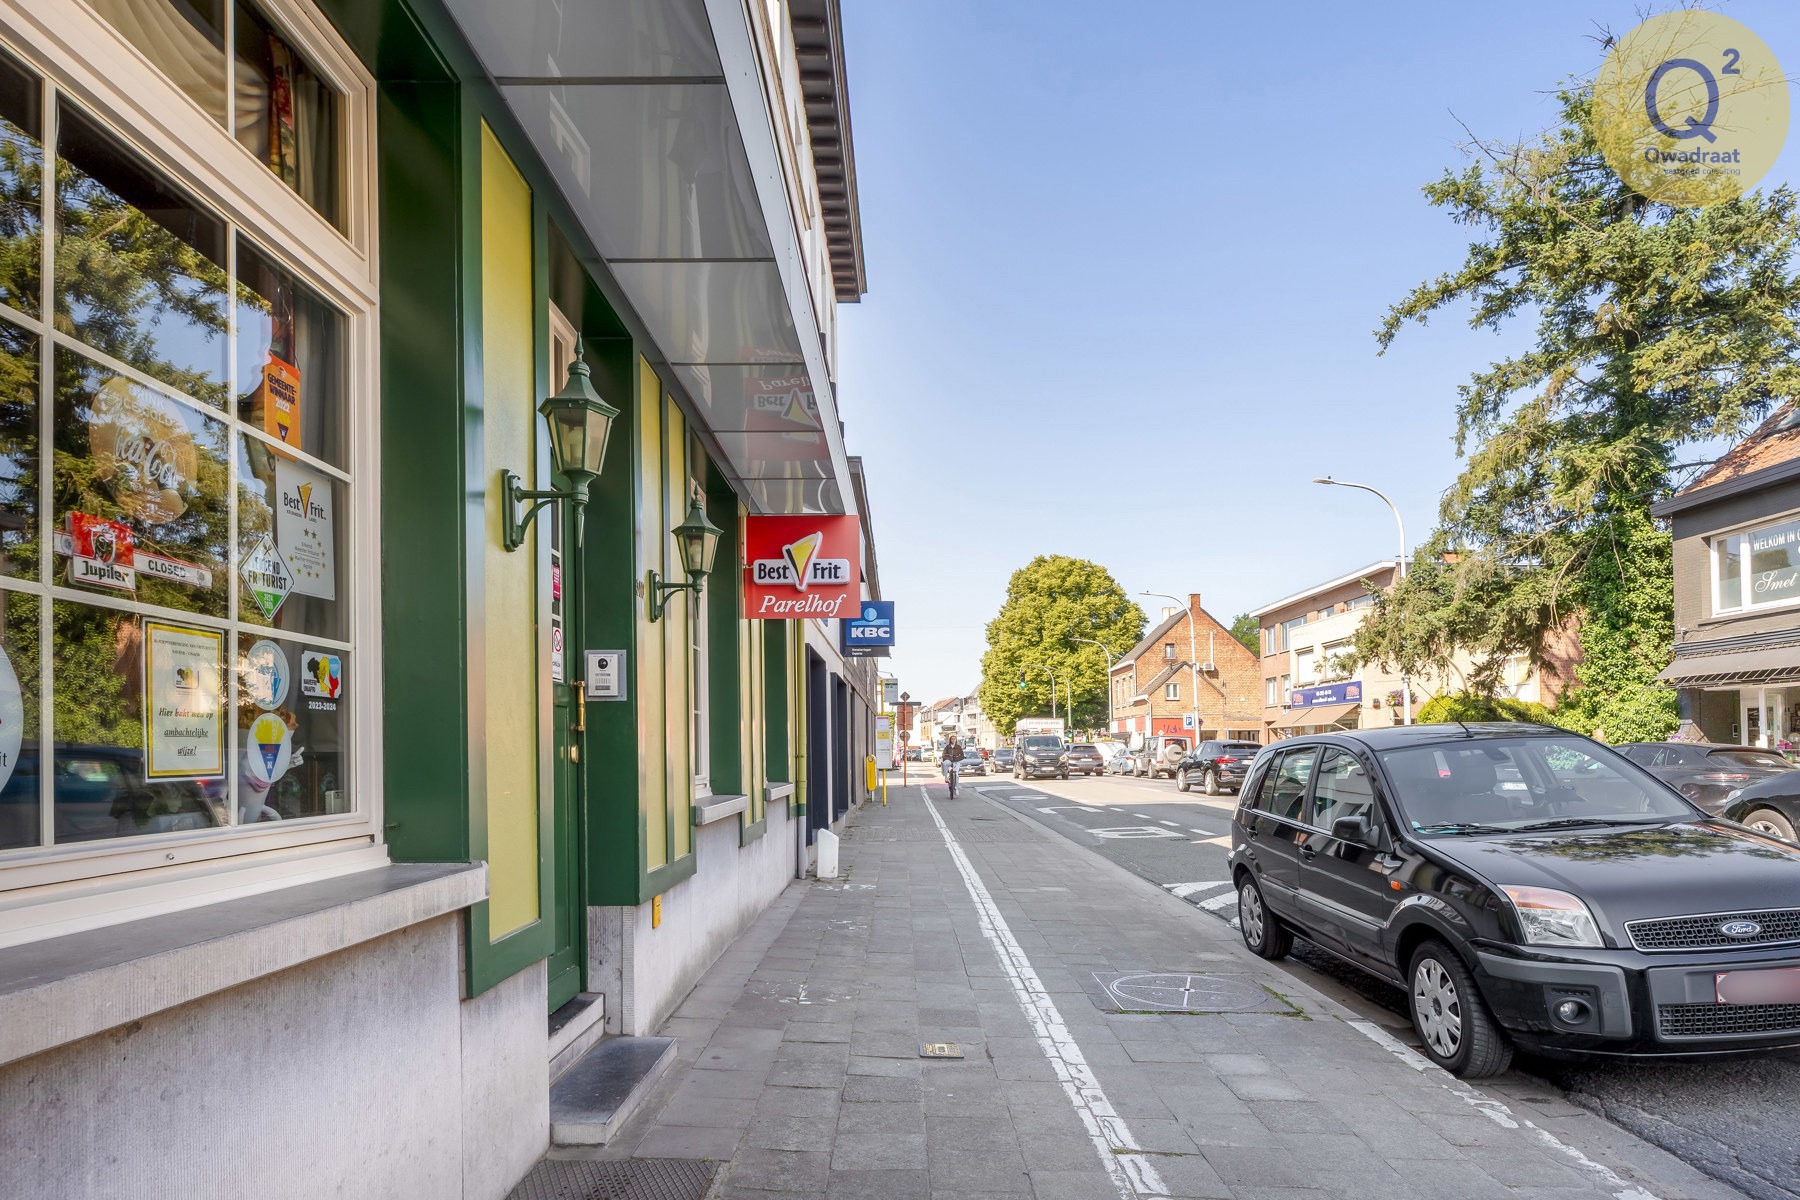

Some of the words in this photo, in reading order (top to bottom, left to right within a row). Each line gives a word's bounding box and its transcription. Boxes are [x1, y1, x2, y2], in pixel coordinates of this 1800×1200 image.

[284, 492, 300, 511] Best
[1754, 532, 1785, 551] WELKOM
[1787, 530, 1795, 543] IN
[82, 560, 129, 582] Jupiler
[148, 559, 186, 577] CLOSED
[758, 562, 789, 579] Best
[813, 562, 841, 579] Frit
[248, 570, 287, 590] FRTURIST
[1754, 571, 1798, 593] Smet
[758, 594, 847, 616] Parelhof
[851, 627, 890, 638] KBC
[159, 707, 173, 717] Hier
[206, 712, 213, 720] op
[308, 701, 336, 711] 2023-2024
[164, 727, 209, 738] ambachtelijke
[177, 746, 197, 757] wijze!
[1732, 924, 1753, 934] Ford
